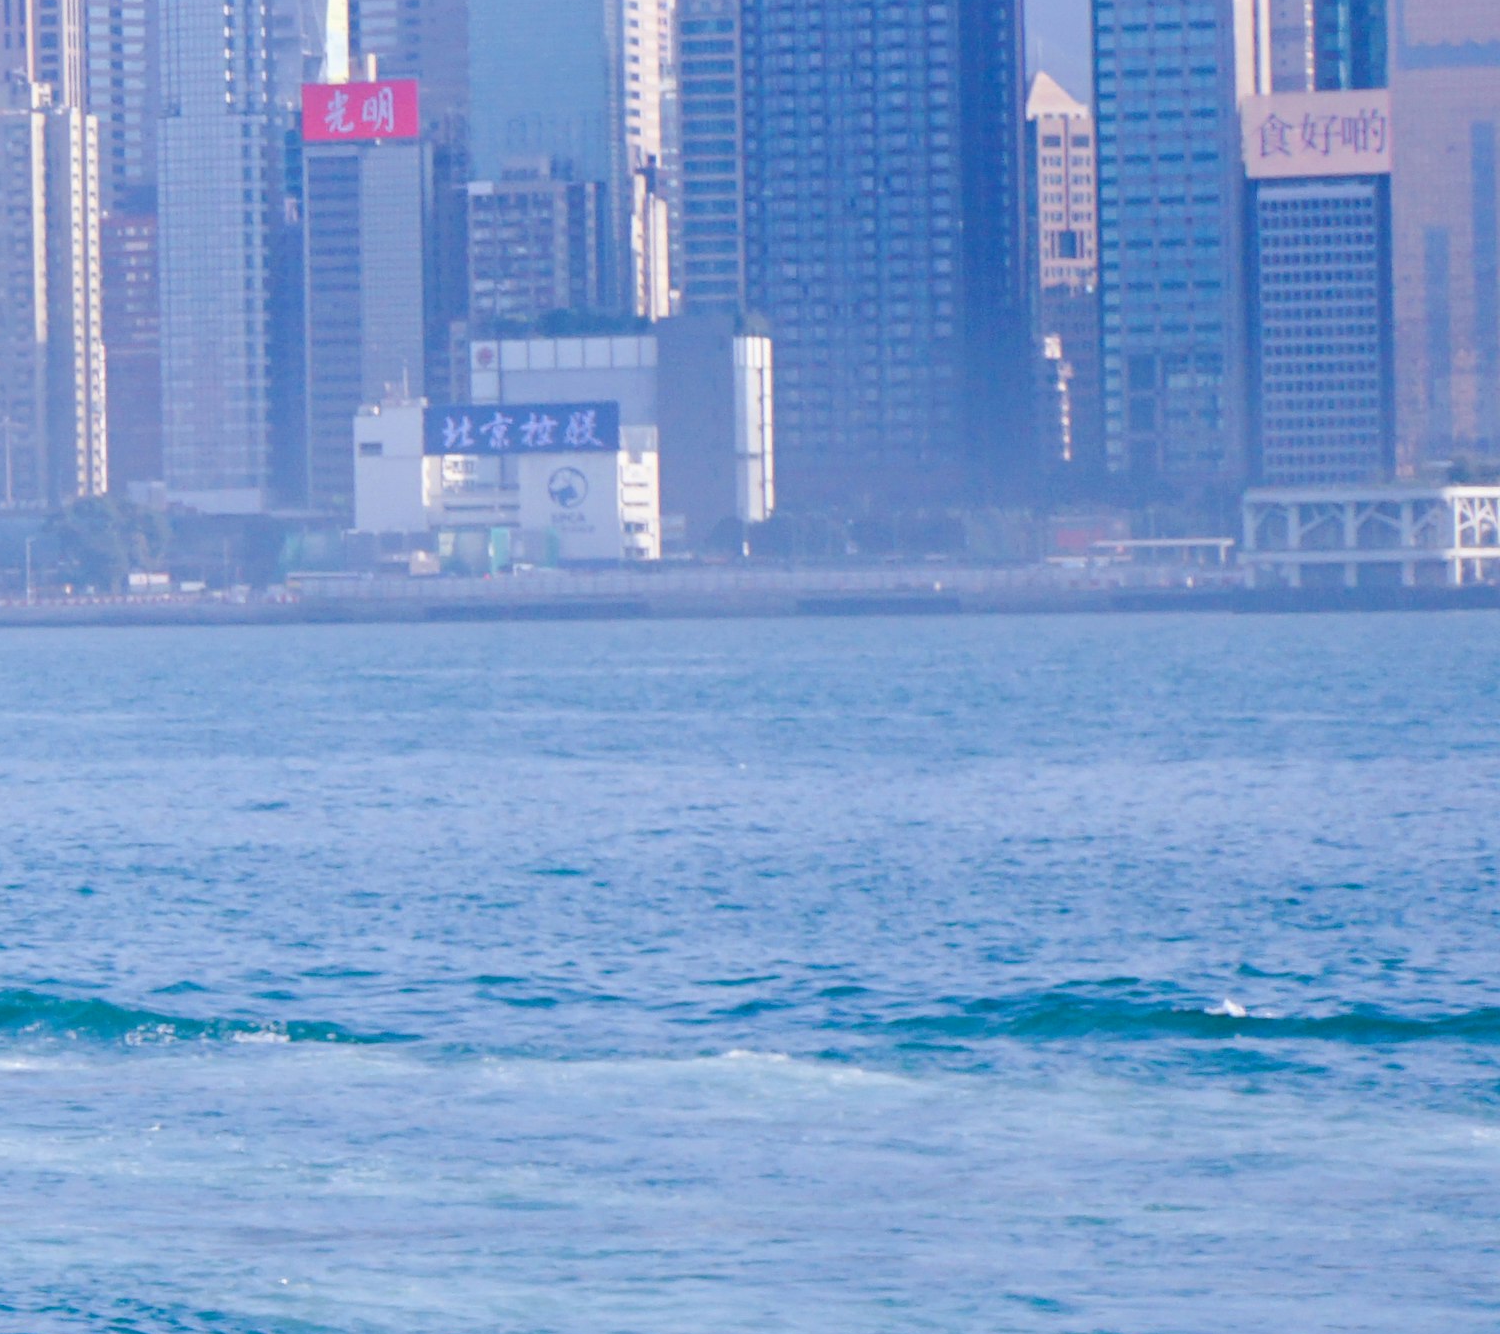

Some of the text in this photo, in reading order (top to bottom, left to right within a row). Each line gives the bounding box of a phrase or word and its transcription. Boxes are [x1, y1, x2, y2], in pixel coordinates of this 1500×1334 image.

[323, 86, 395, 134] 光明
[441, 409, 604, 449] 北京控股
